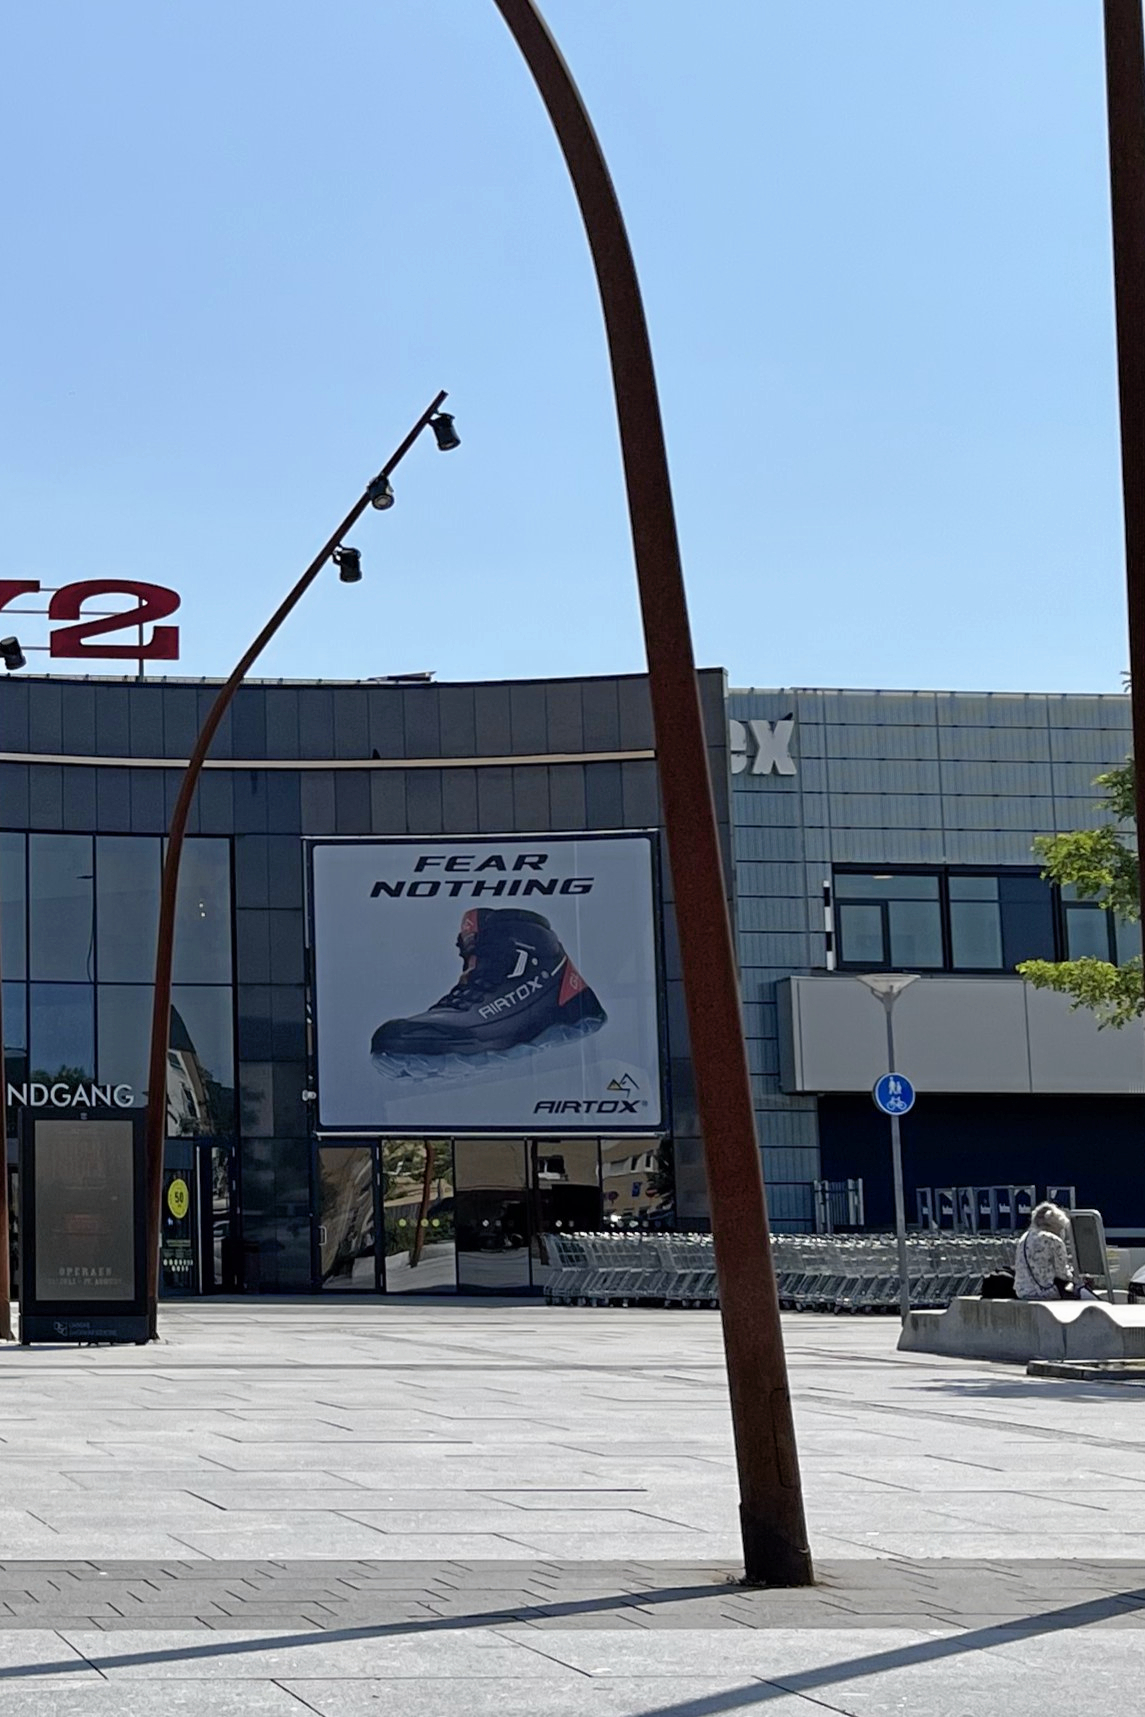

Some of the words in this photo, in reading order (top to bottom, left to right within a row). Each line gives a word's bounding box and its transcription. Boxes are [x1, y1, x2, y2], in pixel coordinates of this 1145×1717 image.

[413, 853, 549, 873] FEAR
[370, 877, 595, 898] NOTHING
[478, 976, 543, 1020] AIRTOX
[7, 1082, 134, 1107] NDGANG
[533, 1100, 640, 1114] AIRTOX
